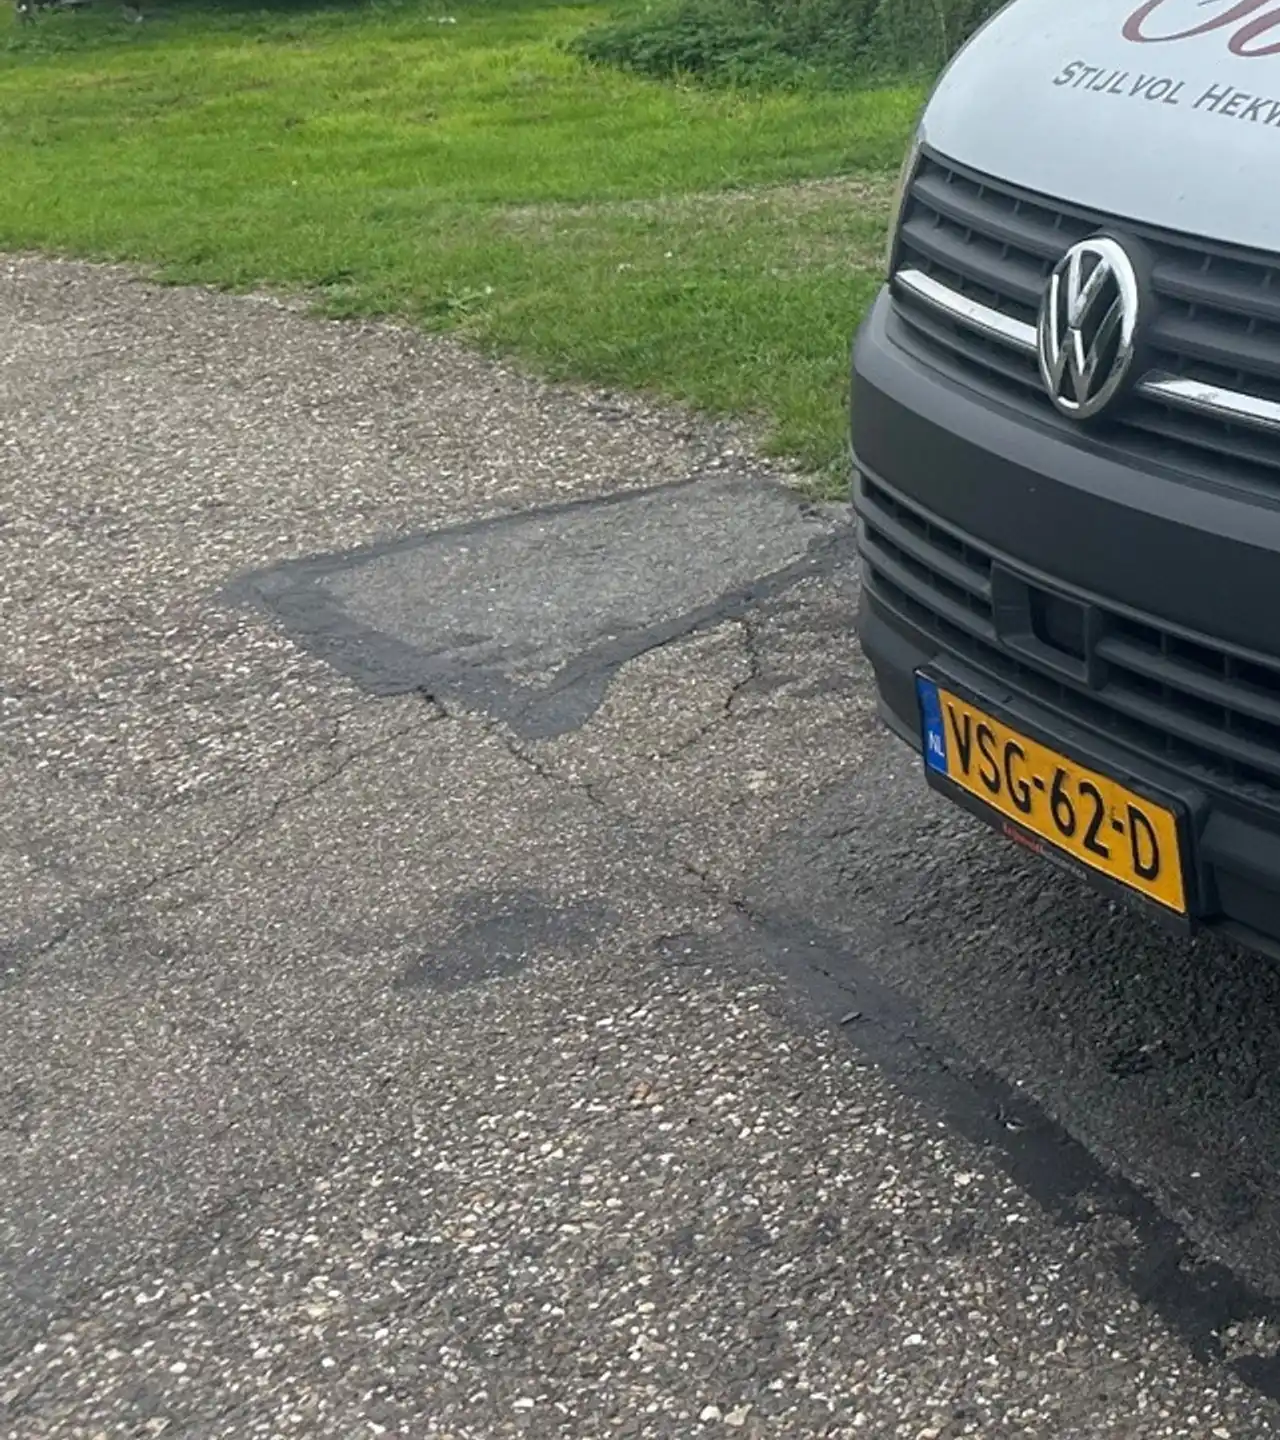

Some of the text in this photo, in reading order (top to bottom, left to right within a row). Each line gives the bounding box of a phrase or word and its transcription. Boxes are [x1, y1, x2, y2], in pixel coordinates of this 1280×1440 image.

[1052, 60, 1187, 107] STIJLVOL
[927, 729, 946, 758] NL
[946, 701, 1161, 882] VSG-62-D
